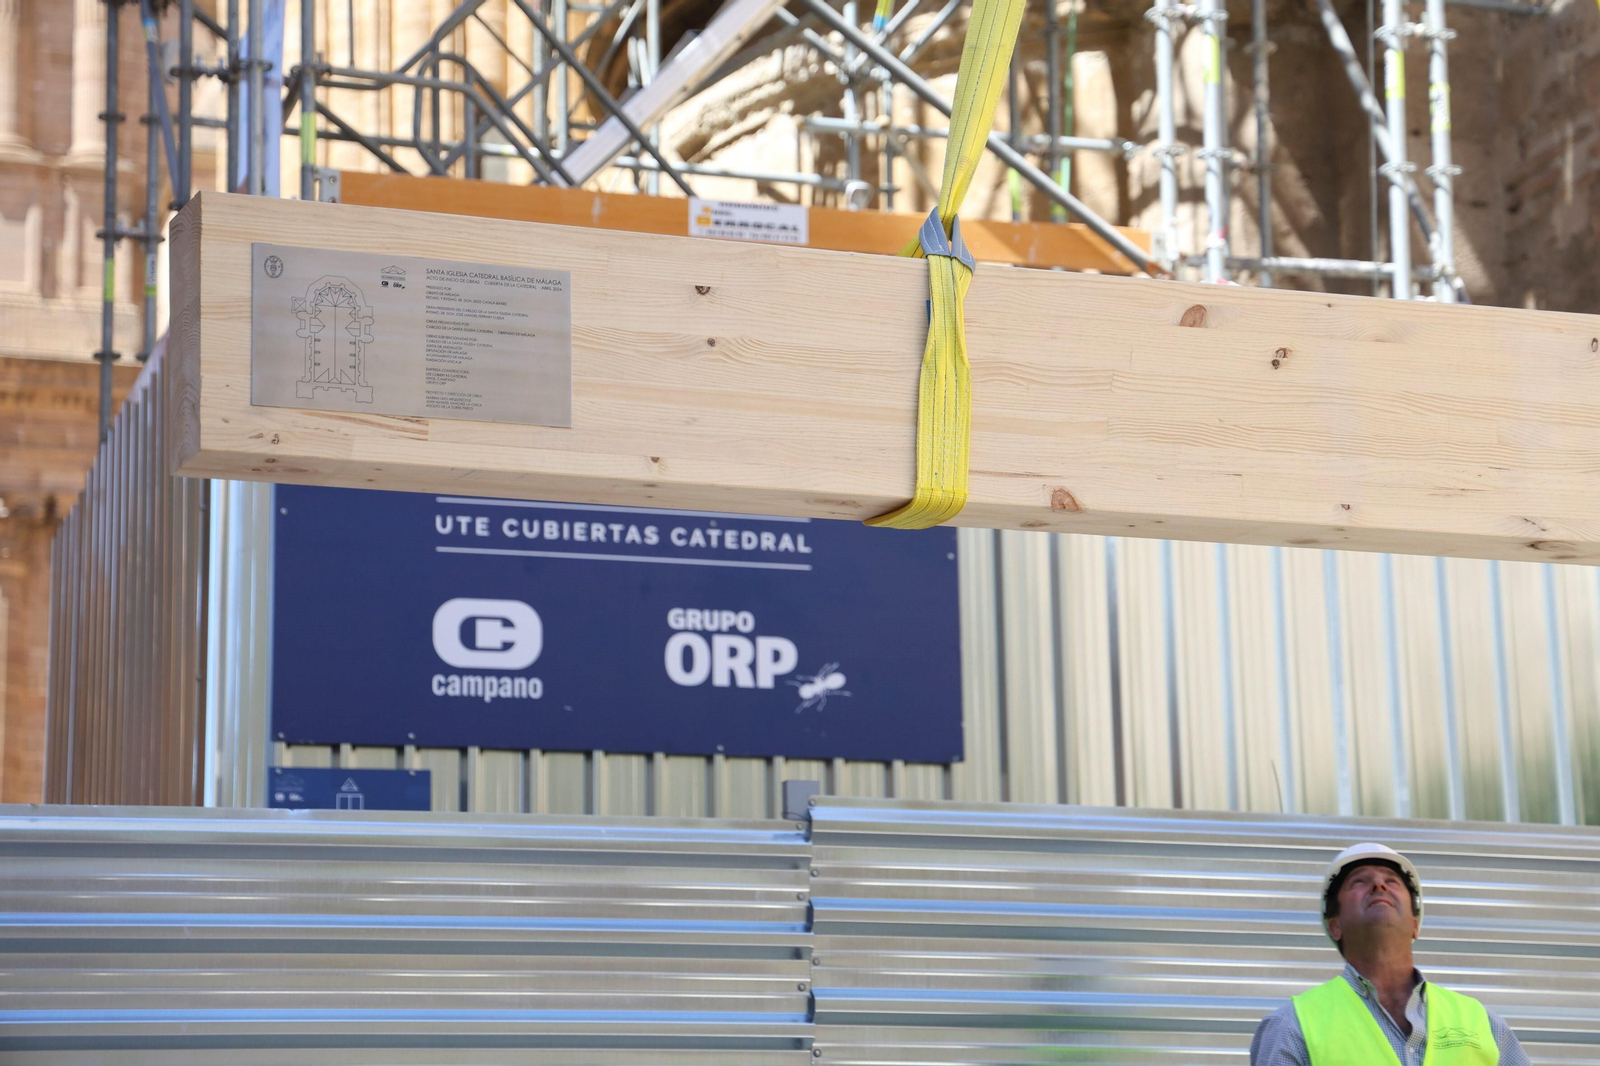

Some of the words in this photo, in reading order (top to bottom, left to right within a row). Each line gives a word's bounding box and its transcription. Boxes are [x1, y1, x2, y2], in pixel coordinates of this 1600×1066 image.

[469, 272, 499, 280] CATEDRAL
[435, 514, 490, 537] UTE
[502, 517, 660, 546] CUBIERTAS
[670, 525, 812, 554] CATEDRAL
[667, 607, 755, 633] GRUPO
[664, 631, 799, 690] ORP
[431, 673, 543, 703] campano
